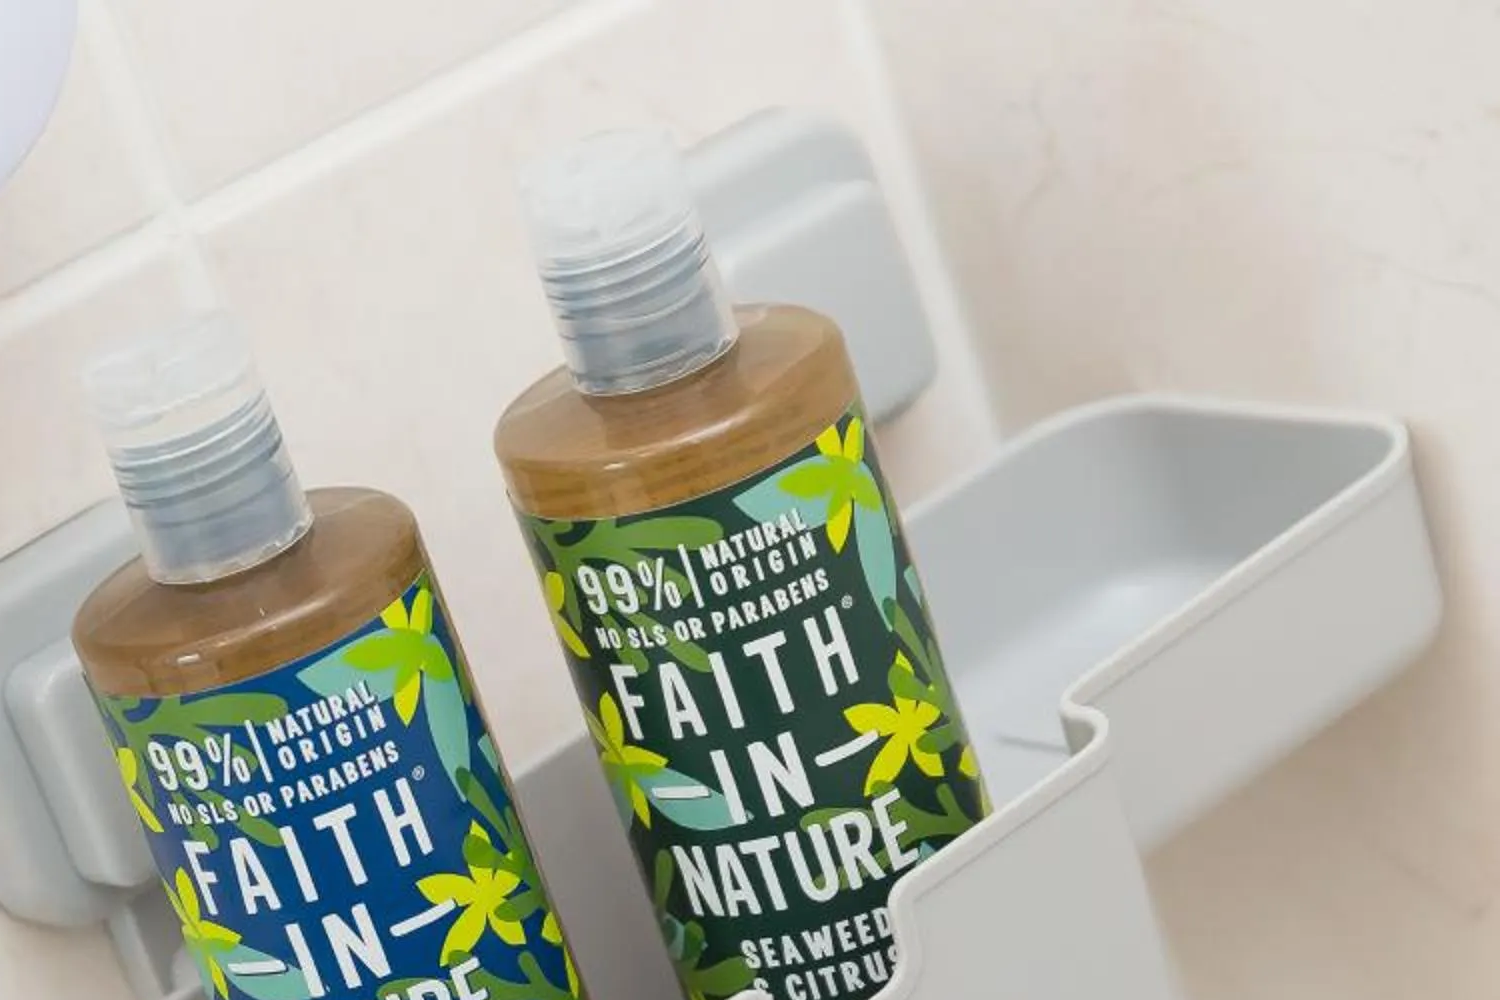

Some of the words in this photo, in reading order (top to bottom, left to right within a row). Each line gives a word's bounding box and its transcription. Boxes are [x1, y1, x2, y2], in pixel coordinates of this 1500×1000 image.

[699, 508, 808, 571] NATURAL
[709, 531, 818, 597] ORIGIN
[577, 556, 683, 616] 99%
[595, 626, 622, 651] NO
[627, 623, 668, 648] SLS
[673, 616, 706, 642] OR
[711, 568, 830, 636] PARABENS
[266, 680, 377, 745] NATURAL
[277, 704, 386, 771] ORIGIN
[148, 732, 250, 792] 99%
[167, 803, 193, 826] NO
[197, 799, 239, 826] SLS
[243, 792, 277, 818] OR
[279, 740, 400, 809] PARABENS
[672, 787, 921, 919] NATURE
[740, 906, 893, 970] SEAWEED
